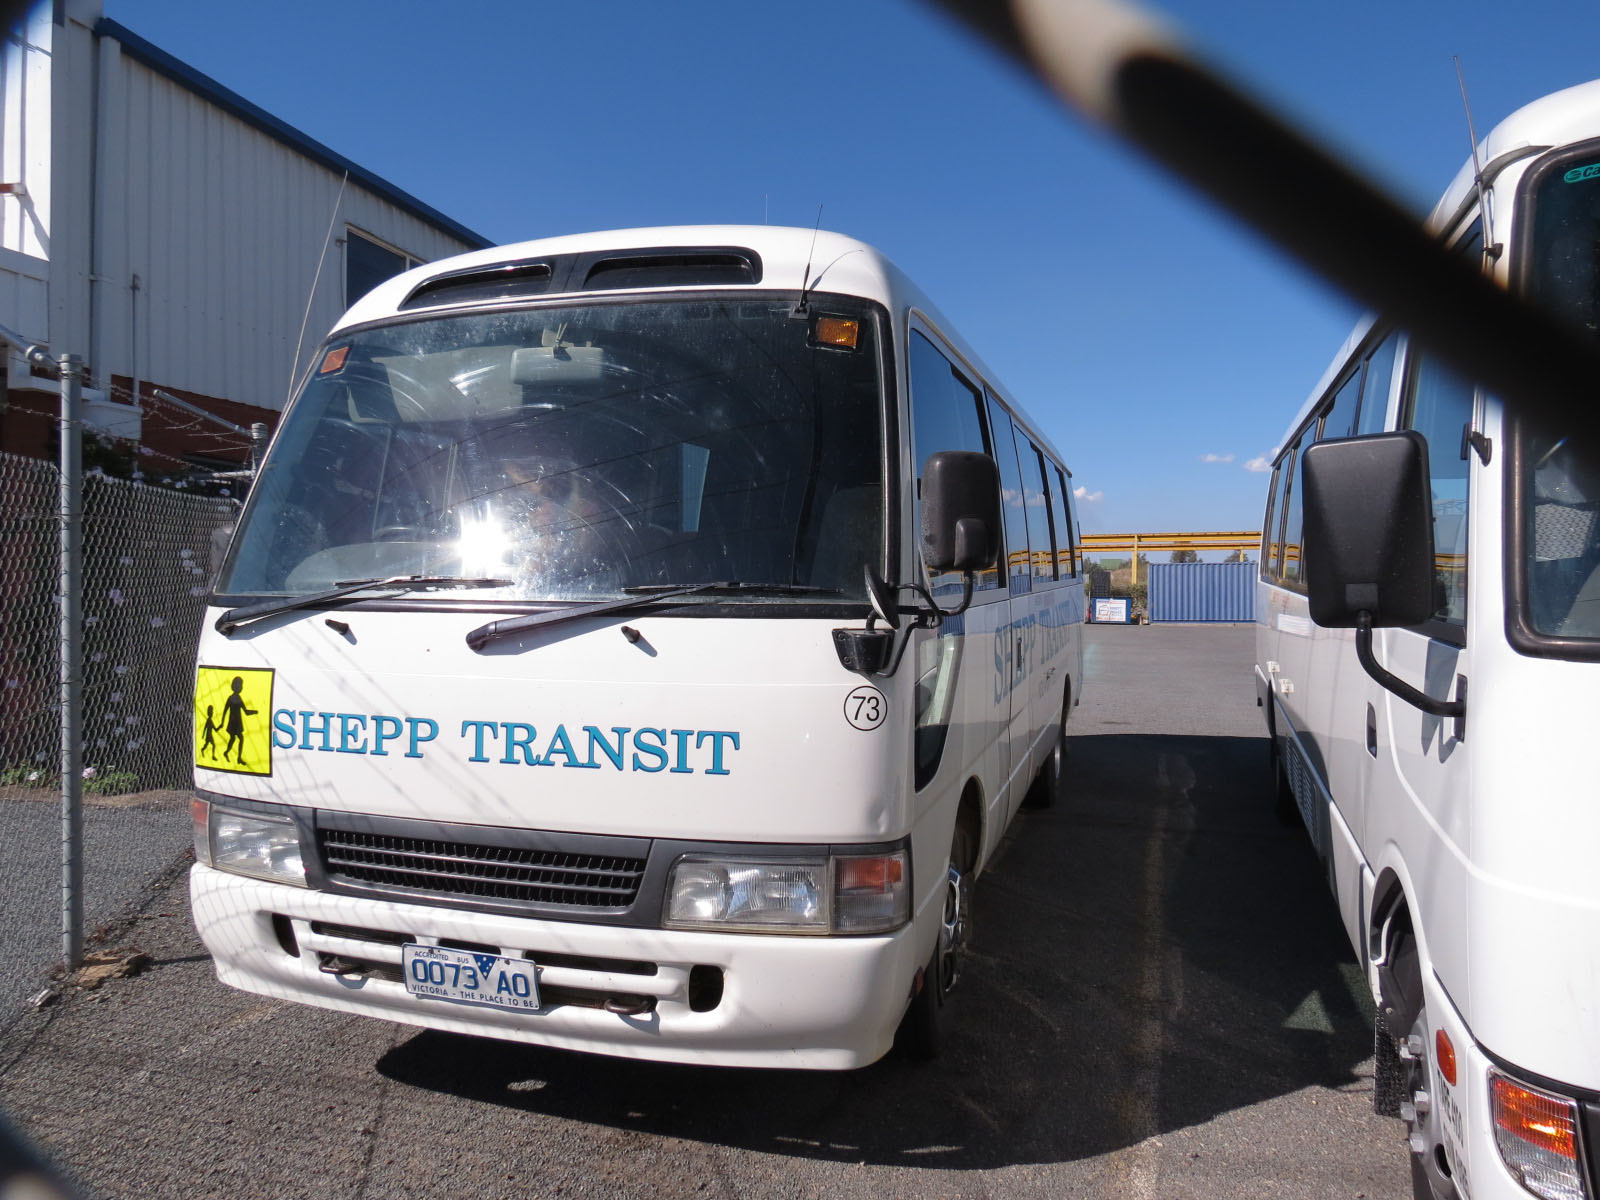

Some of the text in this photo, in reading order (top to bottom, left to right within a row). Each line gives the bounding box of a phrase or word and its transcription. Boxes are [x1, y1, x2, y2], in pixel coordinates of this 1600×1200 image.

[852, 695, 880, 722] 73
[272, 707, 741, 776] SHEPP TRANSIT
[414, 950, 469, 964] ACCREDITED BUS
[411, 958, 480, 990] 0073
[411, 983, 449, 997] VICTORIA
[460, 990, 476, 1000] THE
[479, 993, 504, 1005] PLACE
[508, 998, 519, 1007] TO
